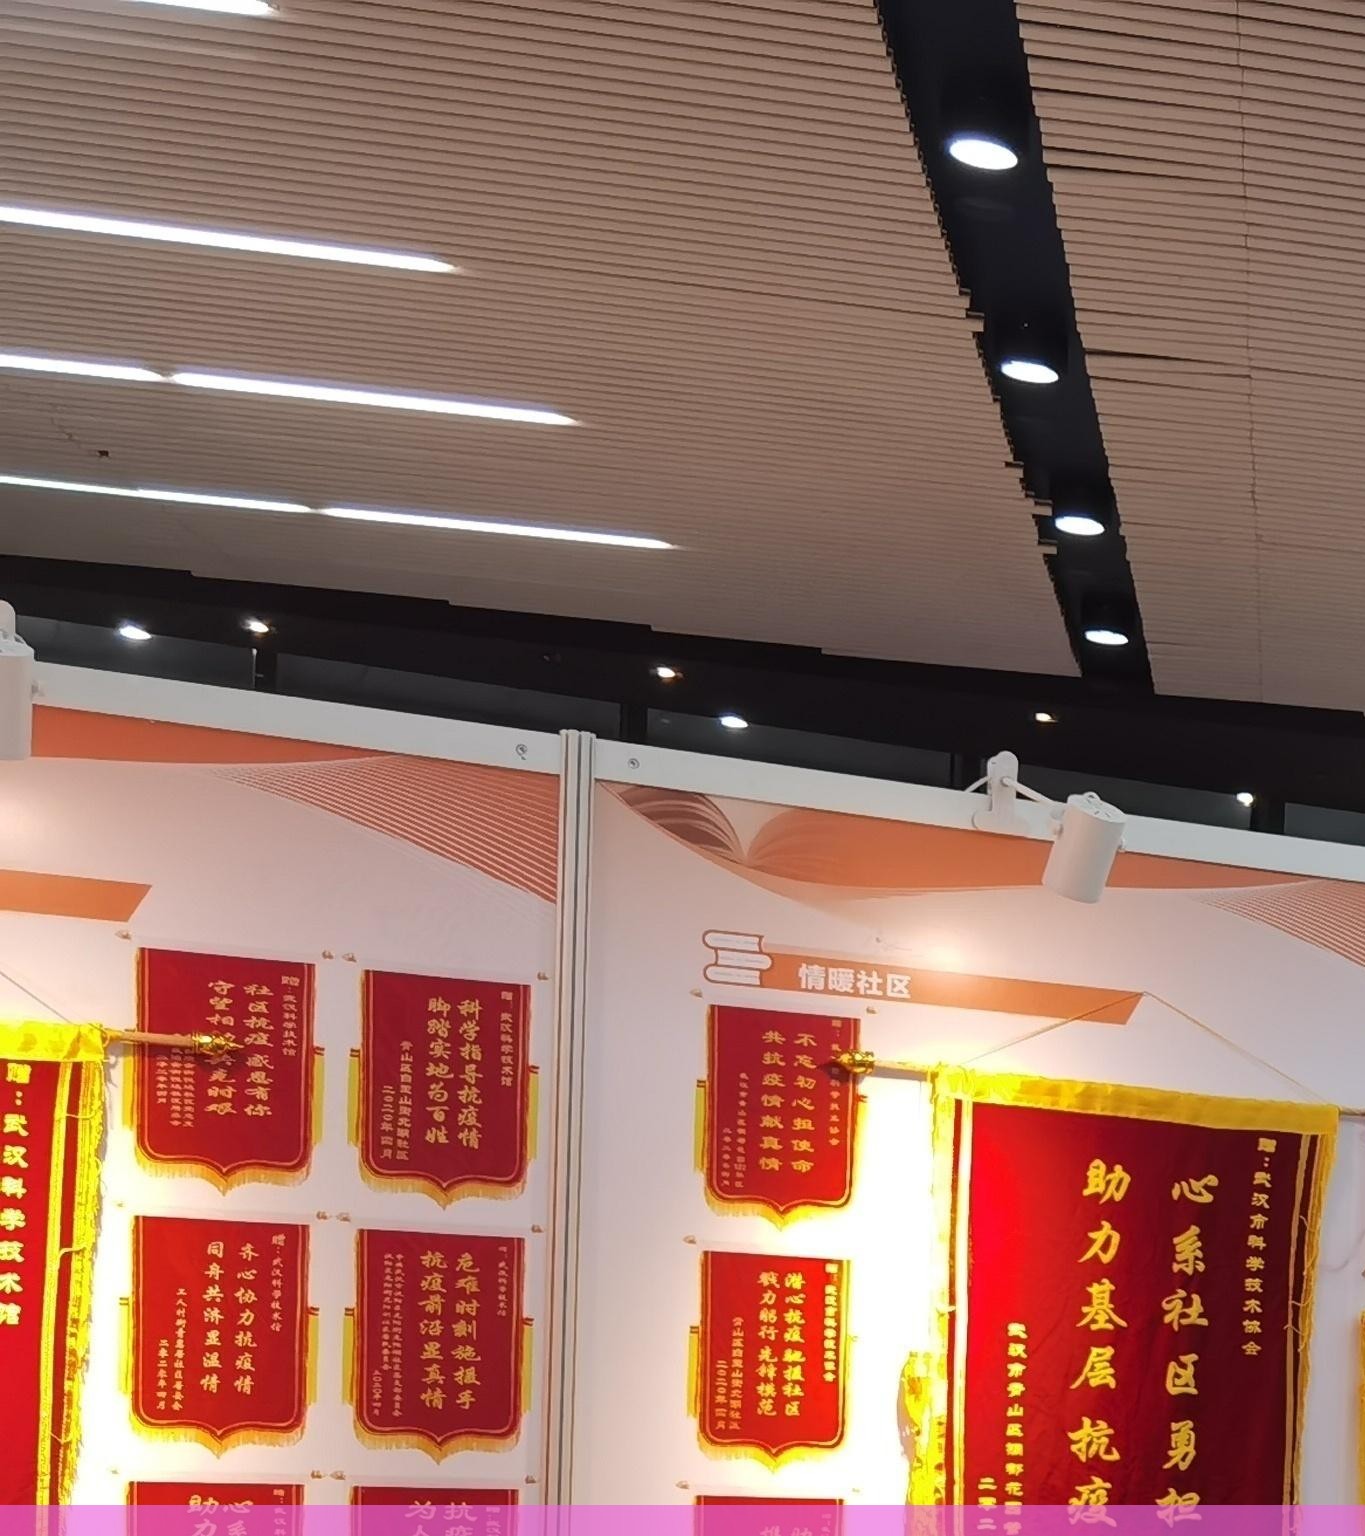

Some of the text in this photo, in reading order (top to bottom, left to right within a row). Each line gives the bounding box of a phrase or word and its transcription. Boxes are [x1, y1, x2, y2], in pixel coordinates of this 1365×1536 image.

[798, 962, 912, 999] 情暖社区
[425, 996, 454, 1145] 脚踏实地为百姓
[456, 998, 484, 1150] 科学指导抗疫情
[200, 1241, 225, 1394] 同舟共济显温情
[233, 1243, 259, 1395] 齐心协力抗疫情
[418, 1250, 449, 1410] 抗疫前沿显真情
[451, 1252, 482, 1410] 危难时刻施援手
